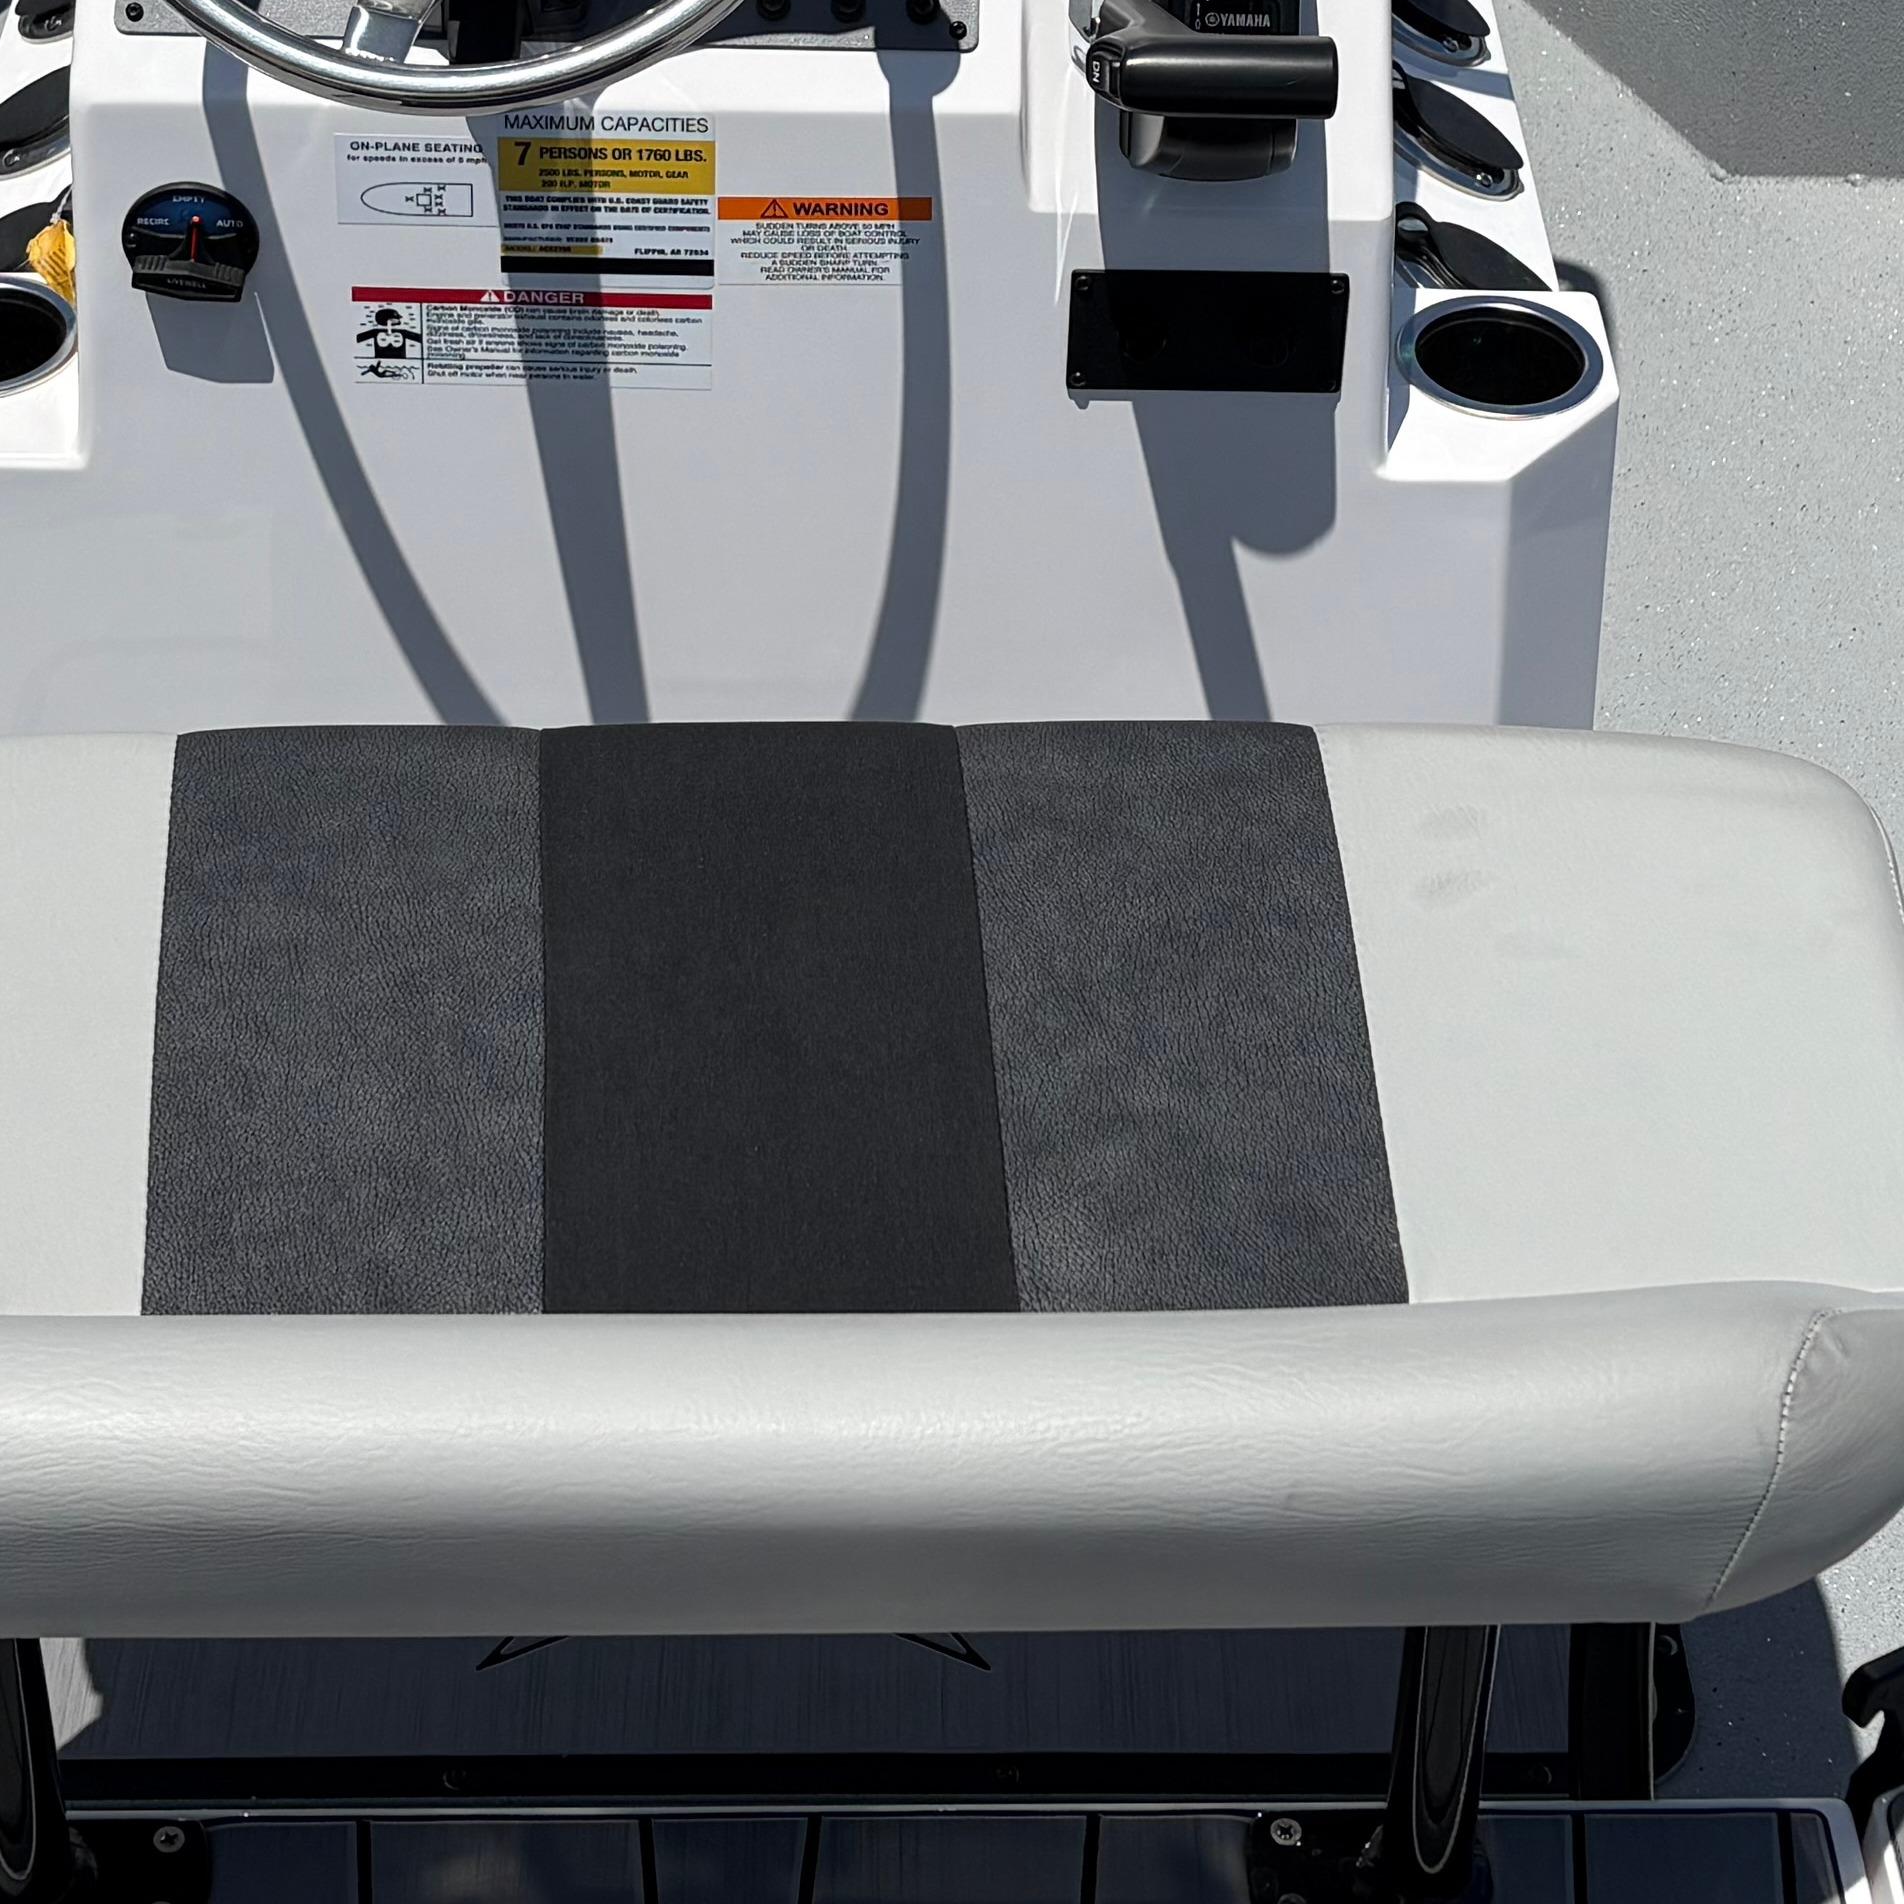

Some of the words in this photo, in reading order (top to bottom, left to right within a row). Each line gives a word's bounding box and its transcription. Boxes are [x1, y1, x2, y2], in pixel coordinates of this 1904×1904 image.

[1220, 14, 1271, 27] YAMAHA
[1092, 61, 1101, 83] DN
[504, 114, 596, 131] MAXIMUM
[601, 116, 709, 133] CAPACITIES
[350, 141, 420, 152] ON-PLANE
[514, 141, 531, 166] 7
[539, 147, 608, 161] PERSONS
[612, 148, 632, 162] OR
[637, 149, 672, 162] 1760
[675, 149, 707, 162] LBS.
[793, 202, 889, 216] WARNING
[216, 219, 244, 228] AUTO
[503, 291, 584, 304] DANGER
